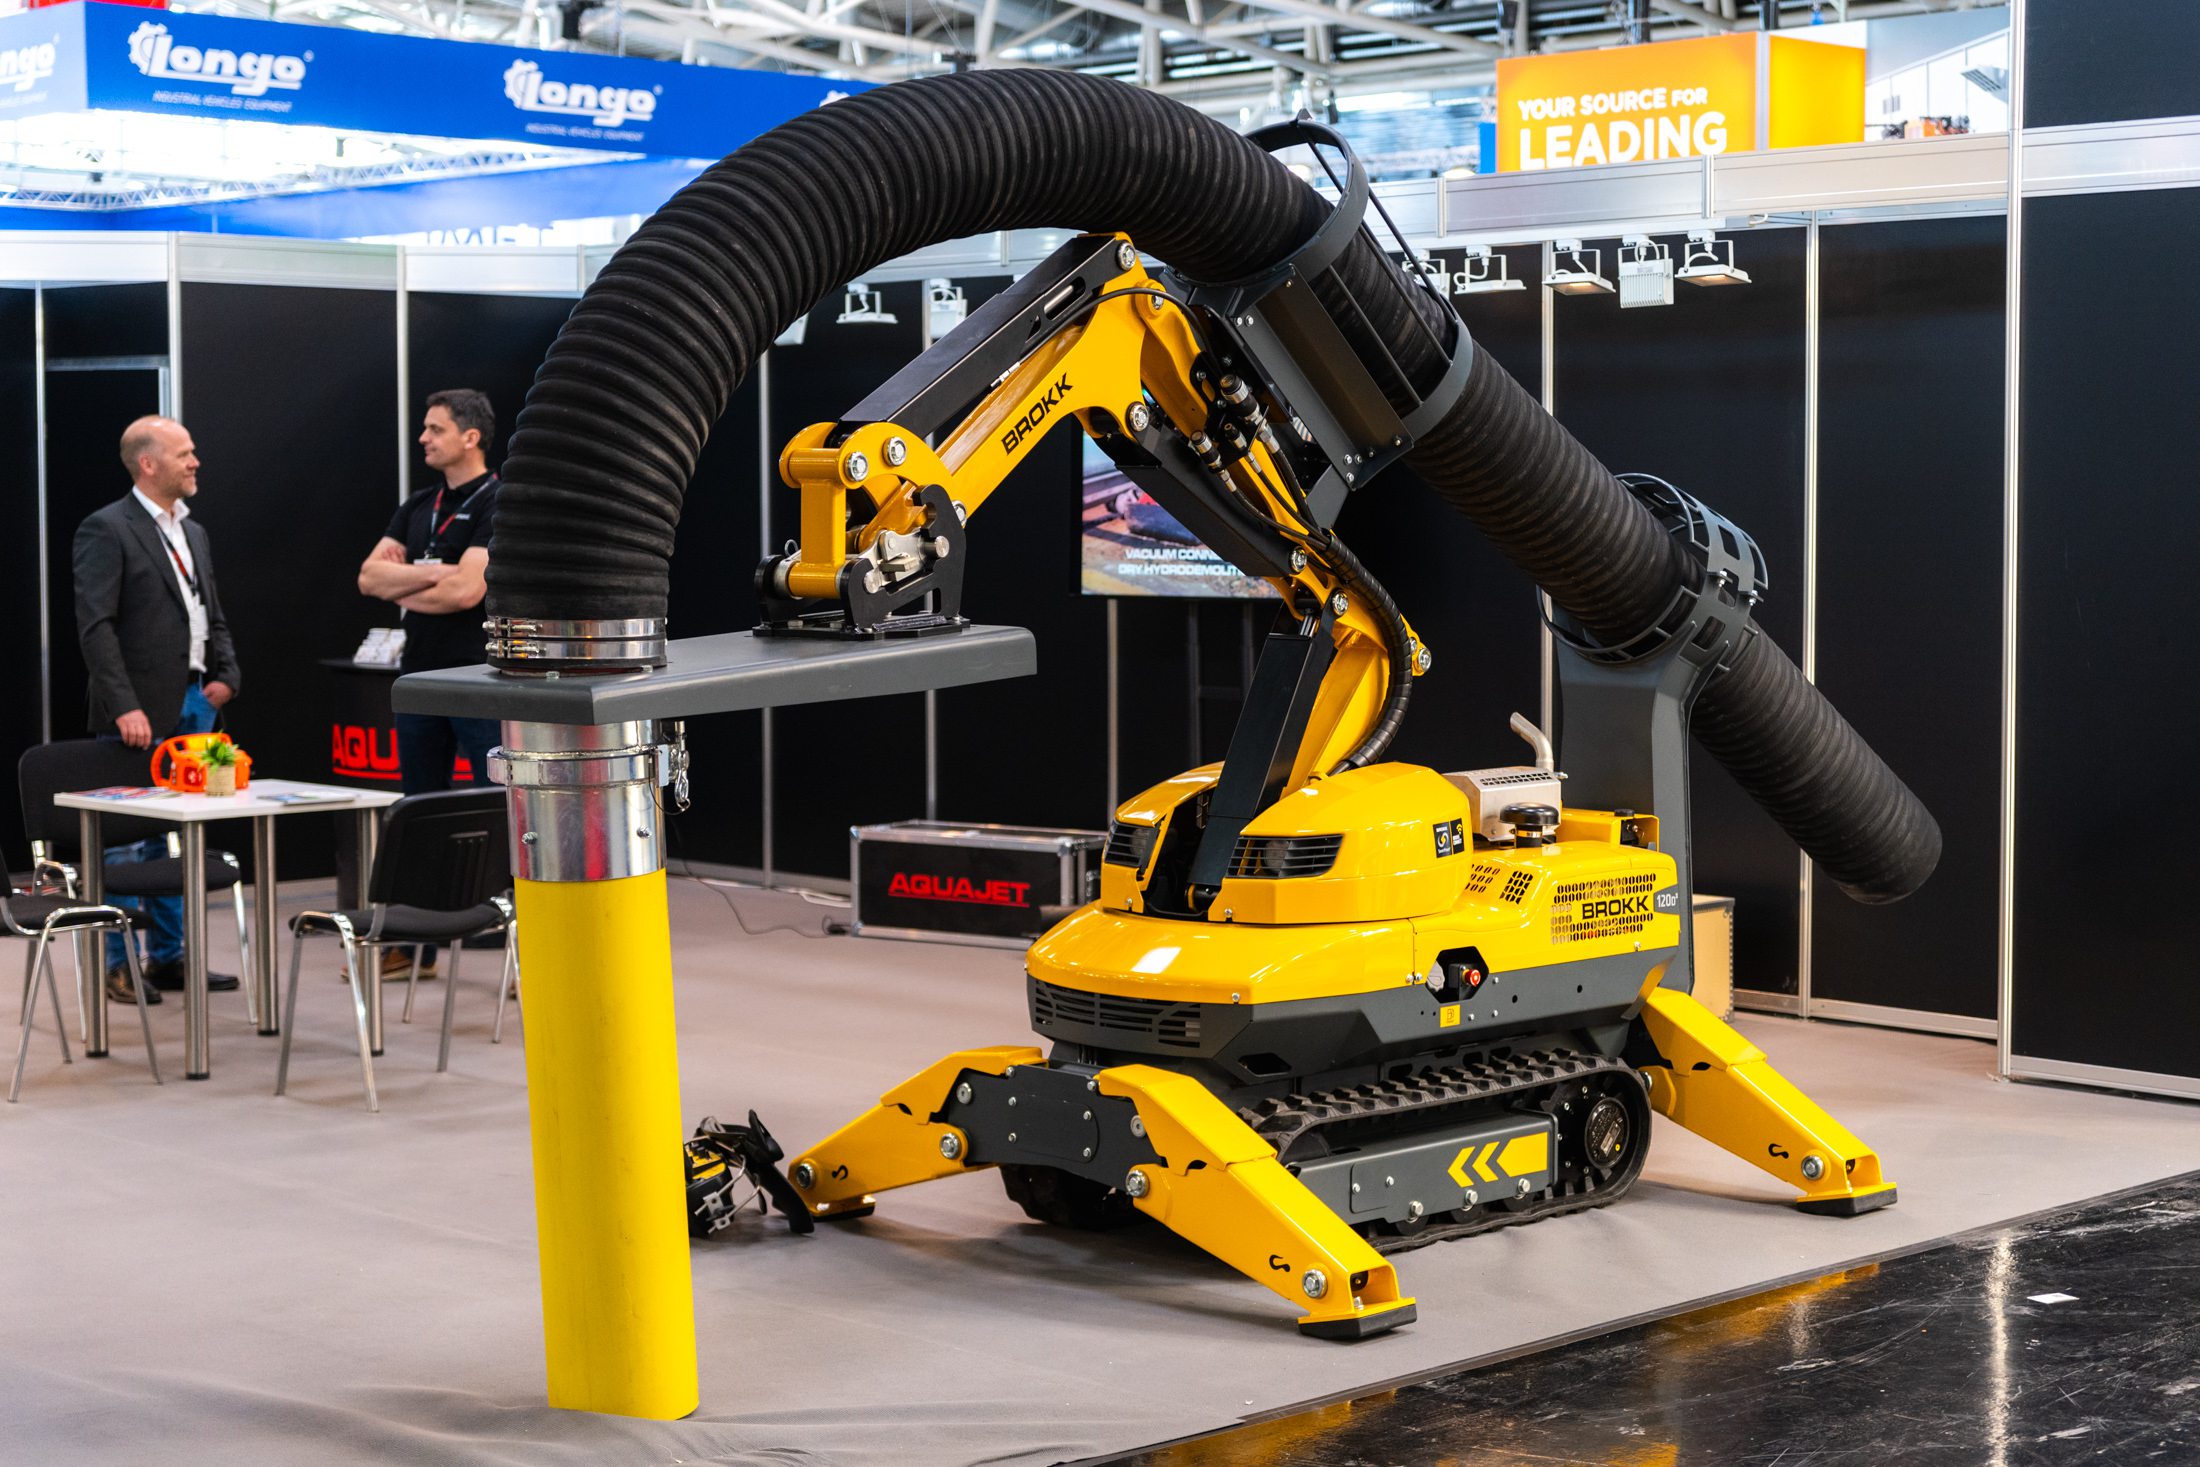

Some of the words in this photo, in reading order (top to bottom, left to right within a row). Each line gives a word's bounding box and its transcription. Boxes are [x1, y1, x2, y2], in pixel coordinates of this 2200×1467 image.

[0, 42, 56, 93] ngo
[1518, 96, 1576, 121] YOUR
[1579, 87, 1667, 115] SOURCE
[1671, 87, 1708, 107] FOR
[1519, 112, 1728, 169] LEADING
[1001, 373, 1073, 455] BROKK
[1125, 548, 1177, 560] VACUUM
[888, 872, 1031, 908] AQUAJET
[1582, 896, 1649, 920] BROKK
